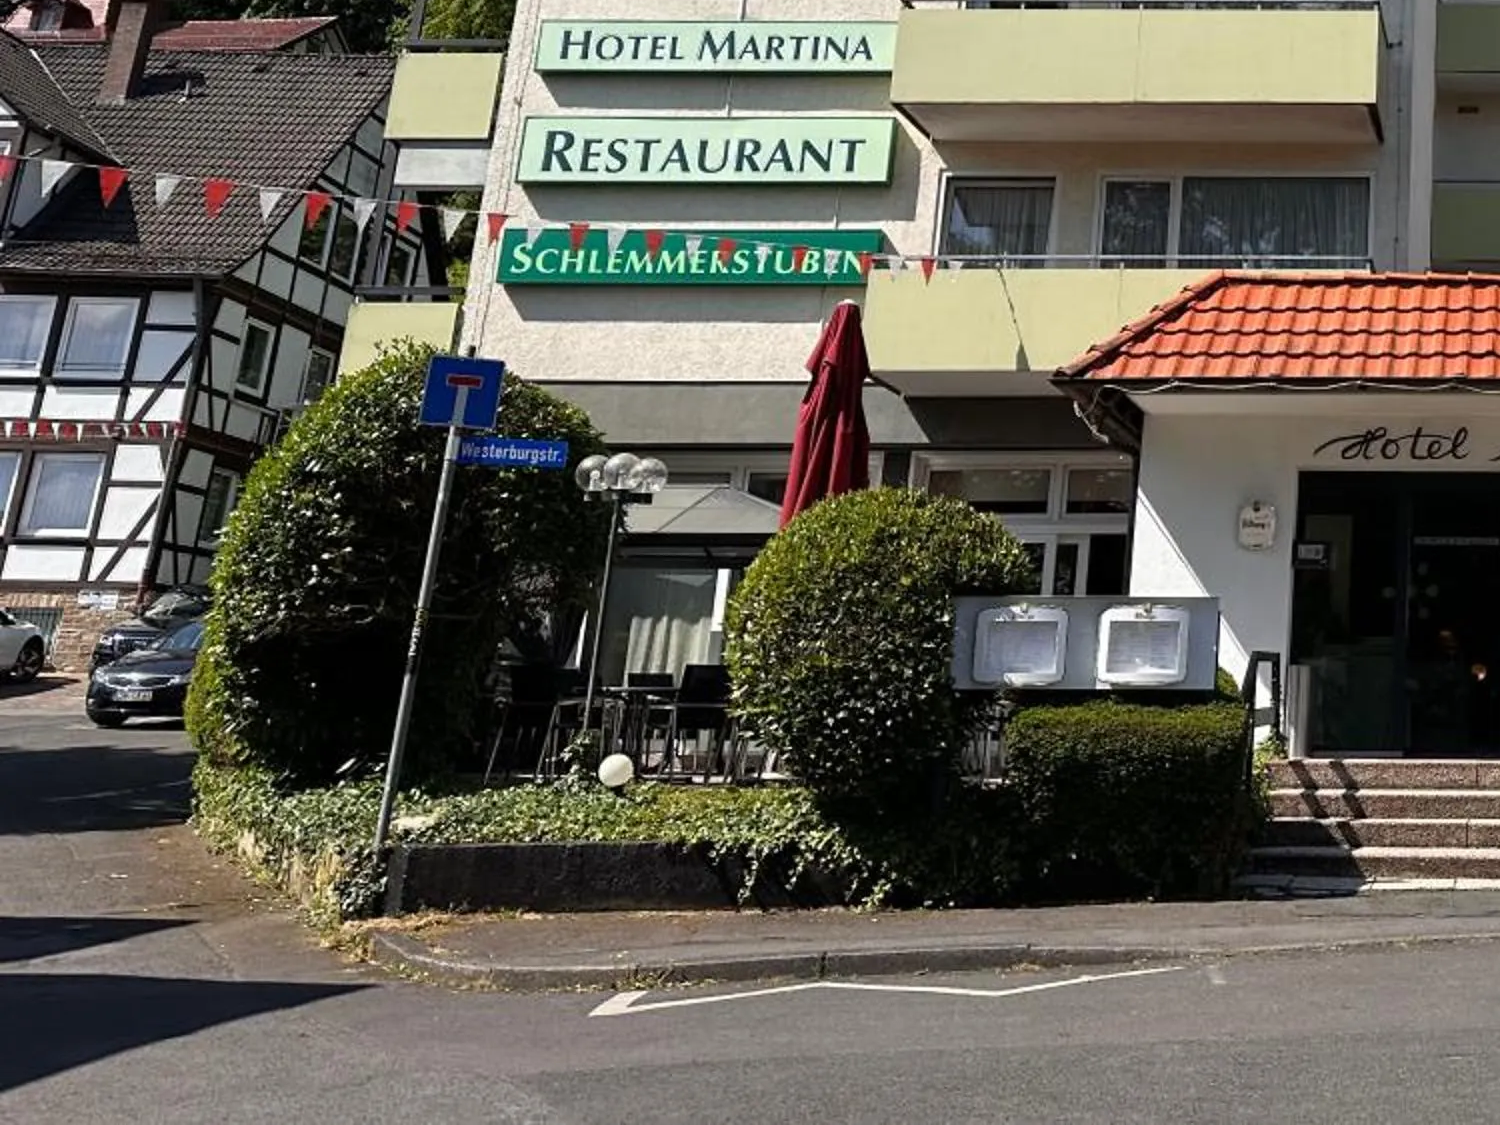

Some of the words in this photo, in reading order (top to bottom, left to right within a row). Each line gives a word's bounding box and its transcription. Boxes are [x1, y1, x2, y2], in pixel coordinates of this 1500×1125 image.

[559, 30, 684, 61] HOTEL
[698, 30, 873, 62] MARTINA
[541, 130, 867, 174] RESTAURANT
[461, 442, 563, 464] Westerburgstr.
[1313, 426, 1469, 461] Hotel
